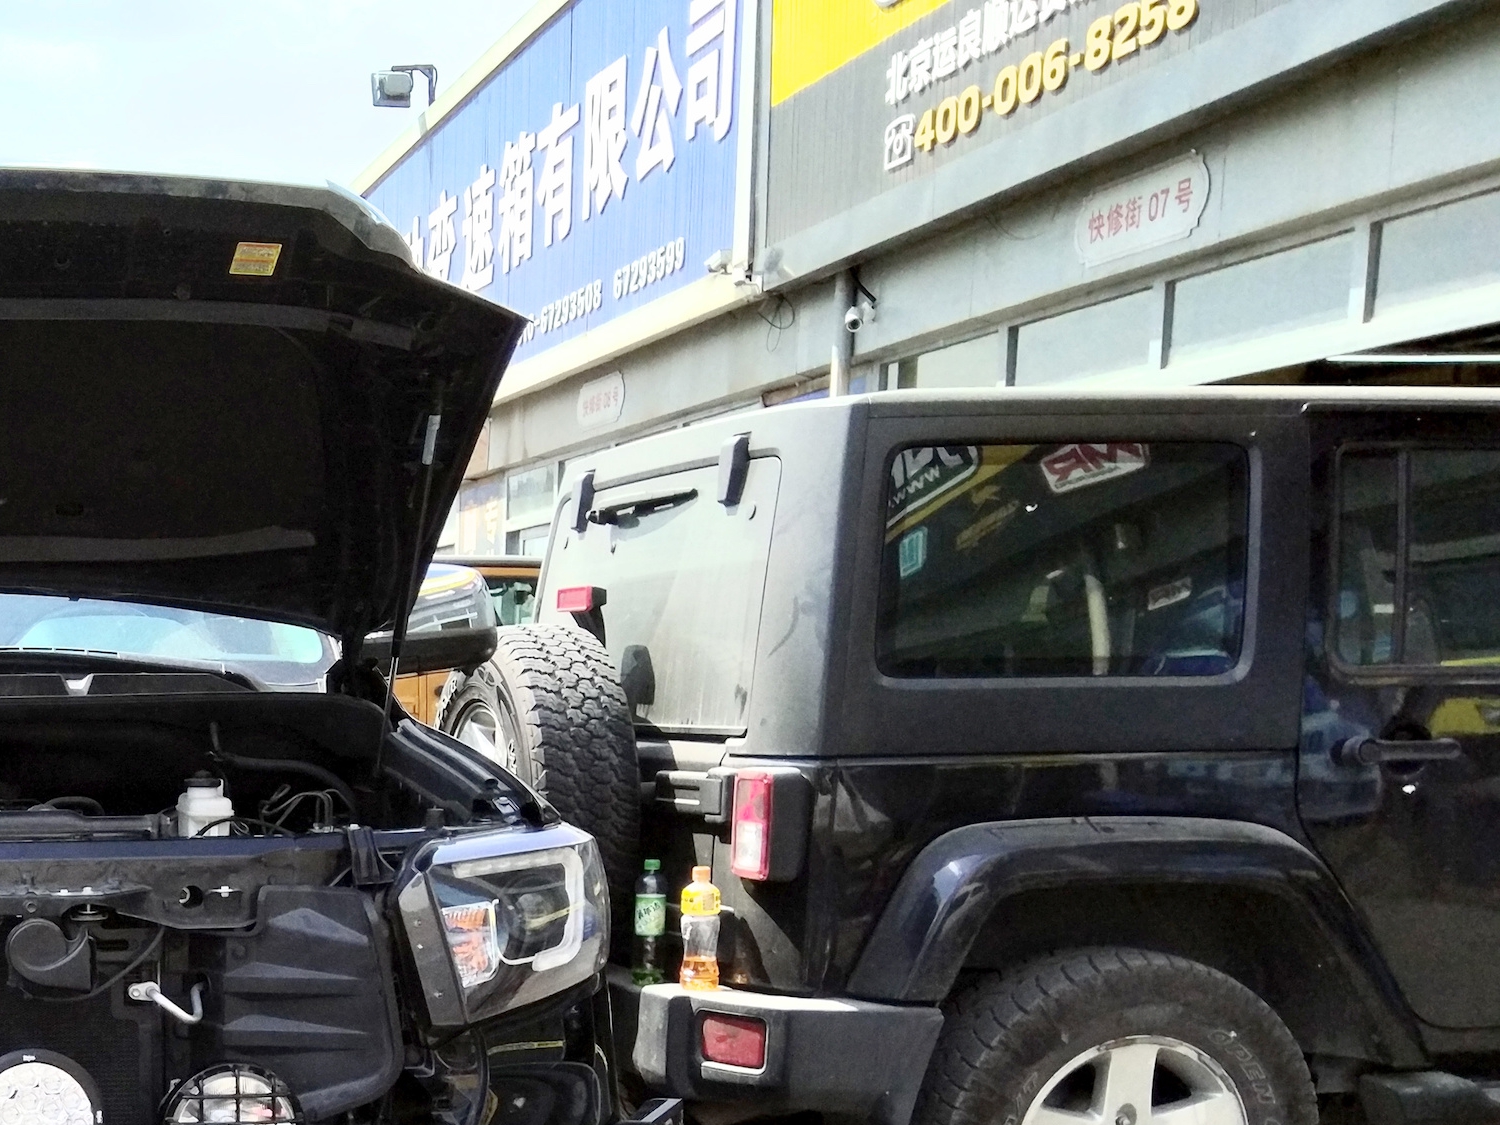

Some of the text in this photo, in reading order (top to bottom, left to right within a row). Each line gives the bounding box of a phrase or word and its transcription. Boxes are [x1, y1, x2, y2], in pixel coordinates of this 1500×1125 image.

[1088, 178, 1193, 244] 快修街 07 号
[517, 237, 686, 346] 10-67293508 67293599
[1207, 1029, 1276, 1104] OPEN
